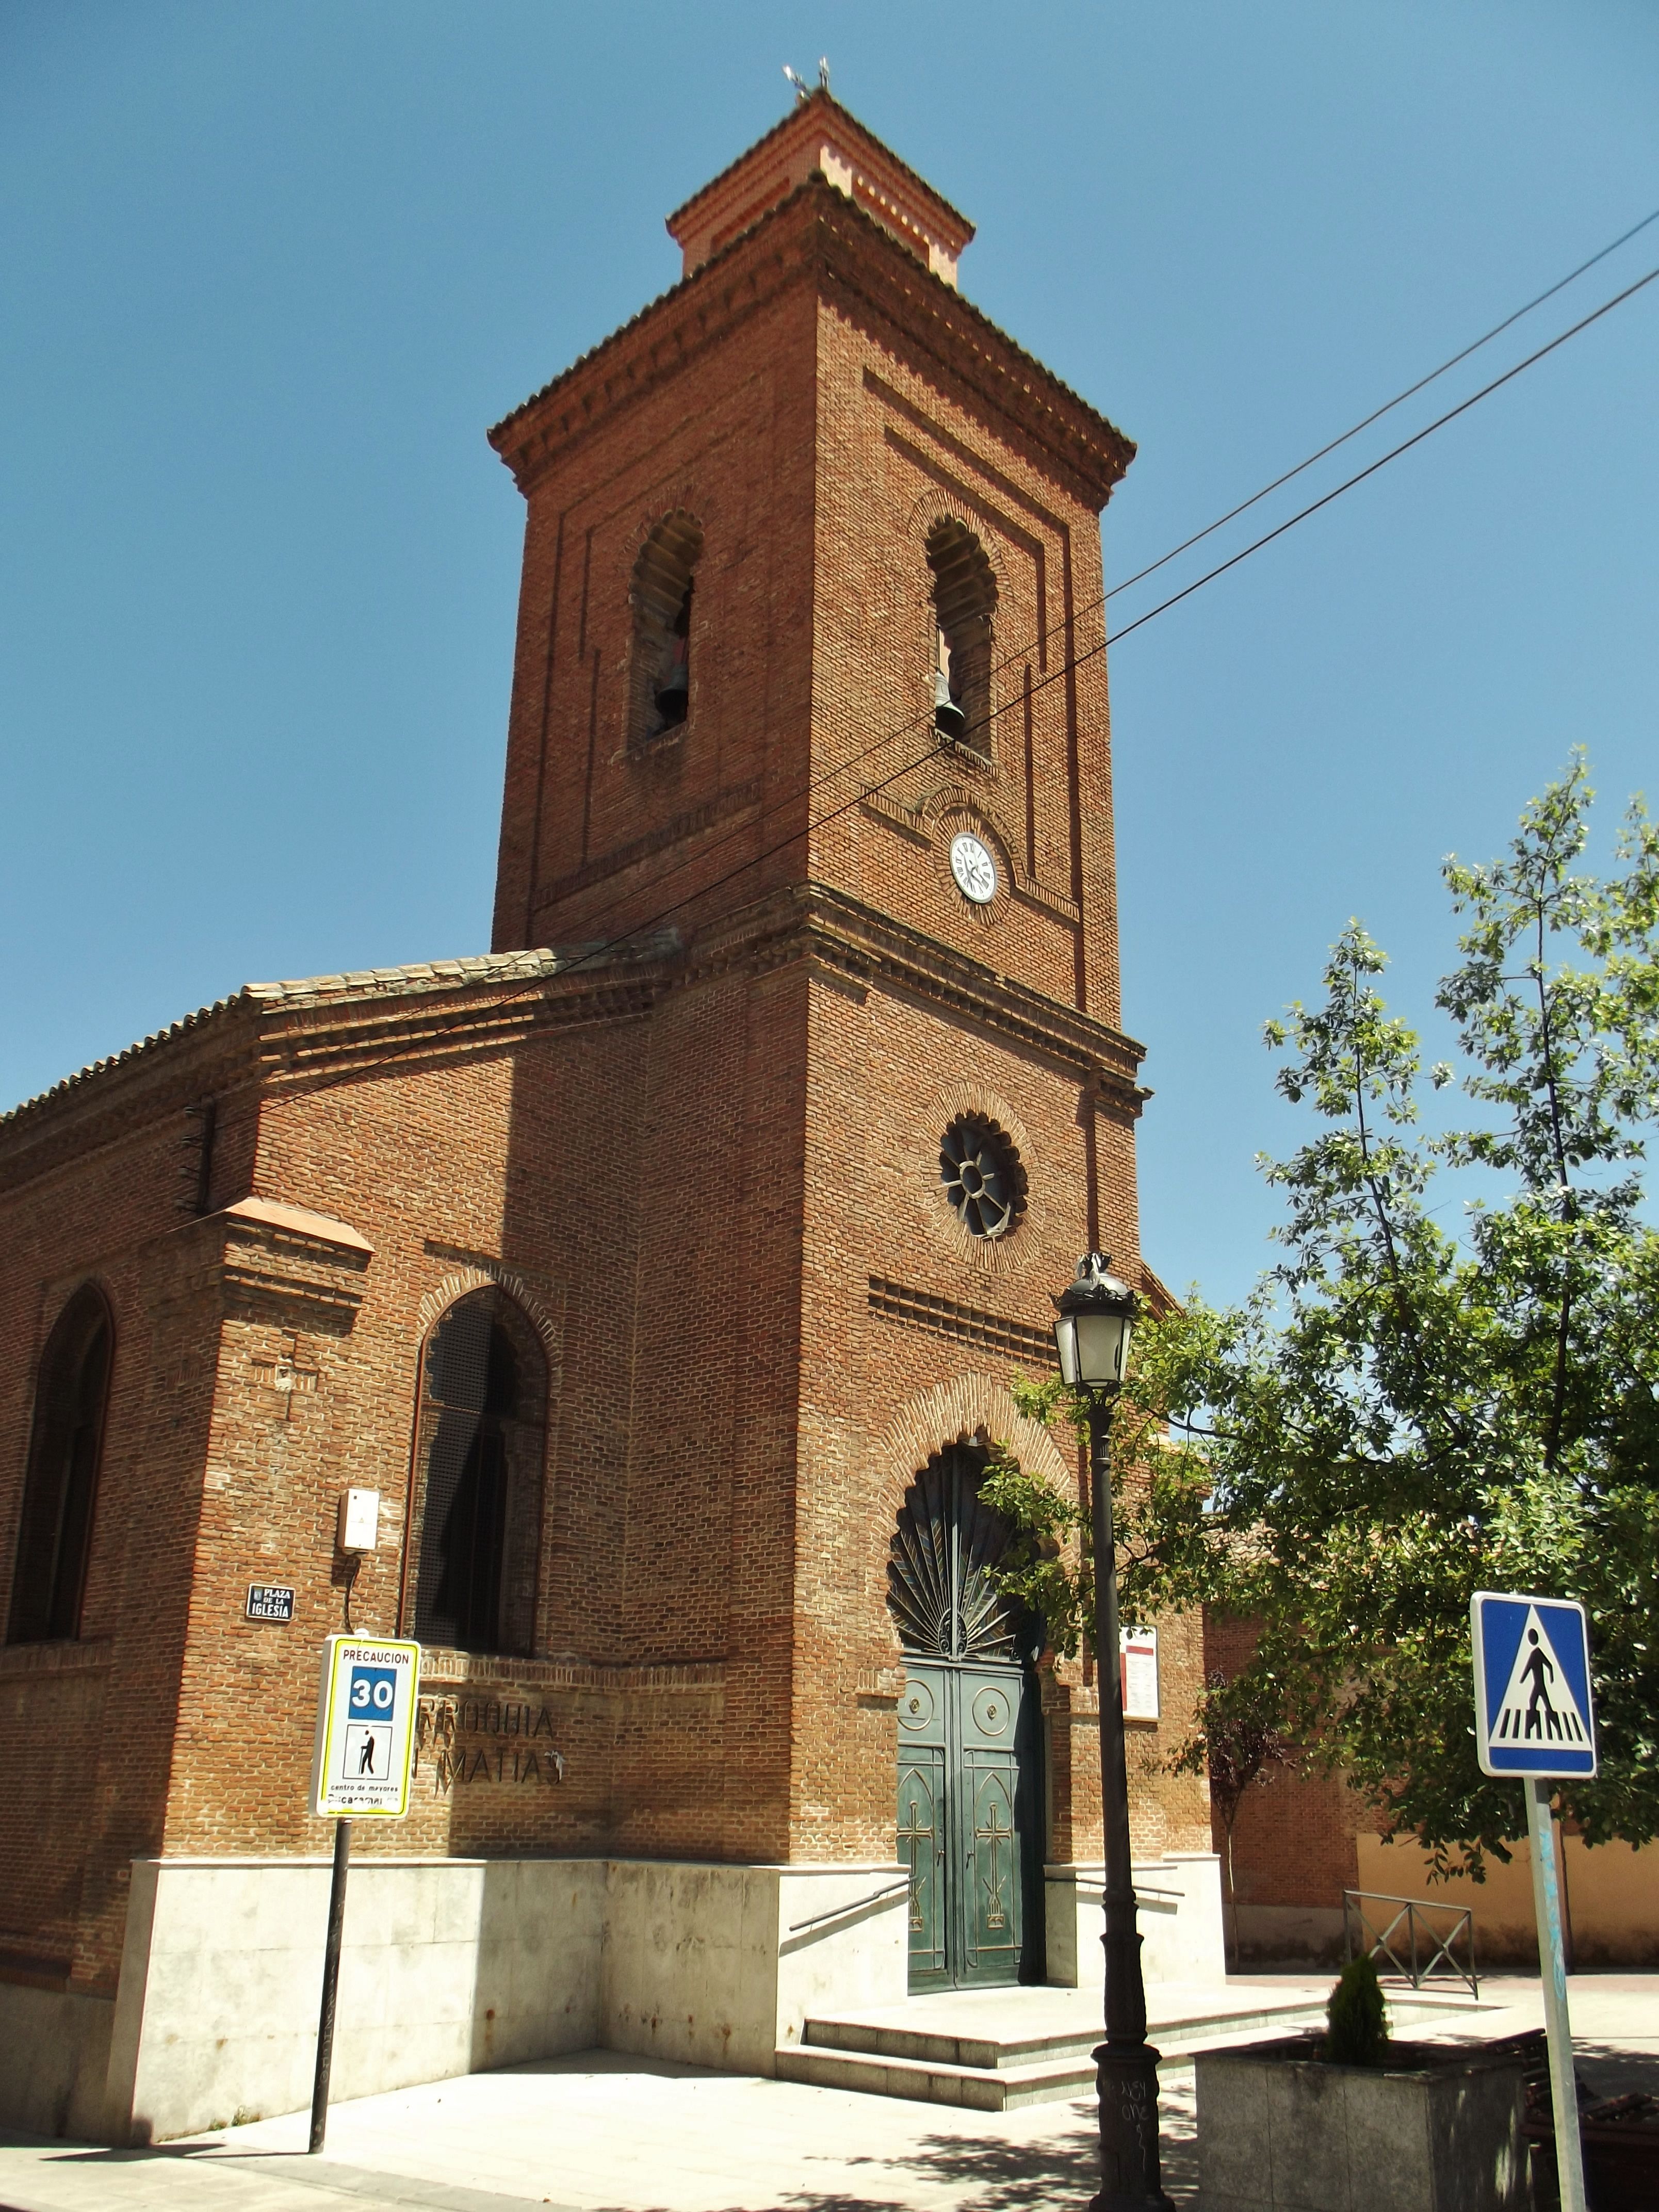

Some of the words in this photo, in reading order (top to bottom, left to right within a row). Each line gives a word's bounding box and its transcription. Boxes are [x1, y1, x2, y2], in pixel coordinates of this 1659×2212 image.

[264, 1588, 290, 1599] PLAZA
[251, 1602, 288, 1618] IGLESIA
[343, 1649, 409, 1665] PRECAUCION
[352, 1679, 393, 1709] 30
[417, 1698, 554, 1739] RROQUIA
